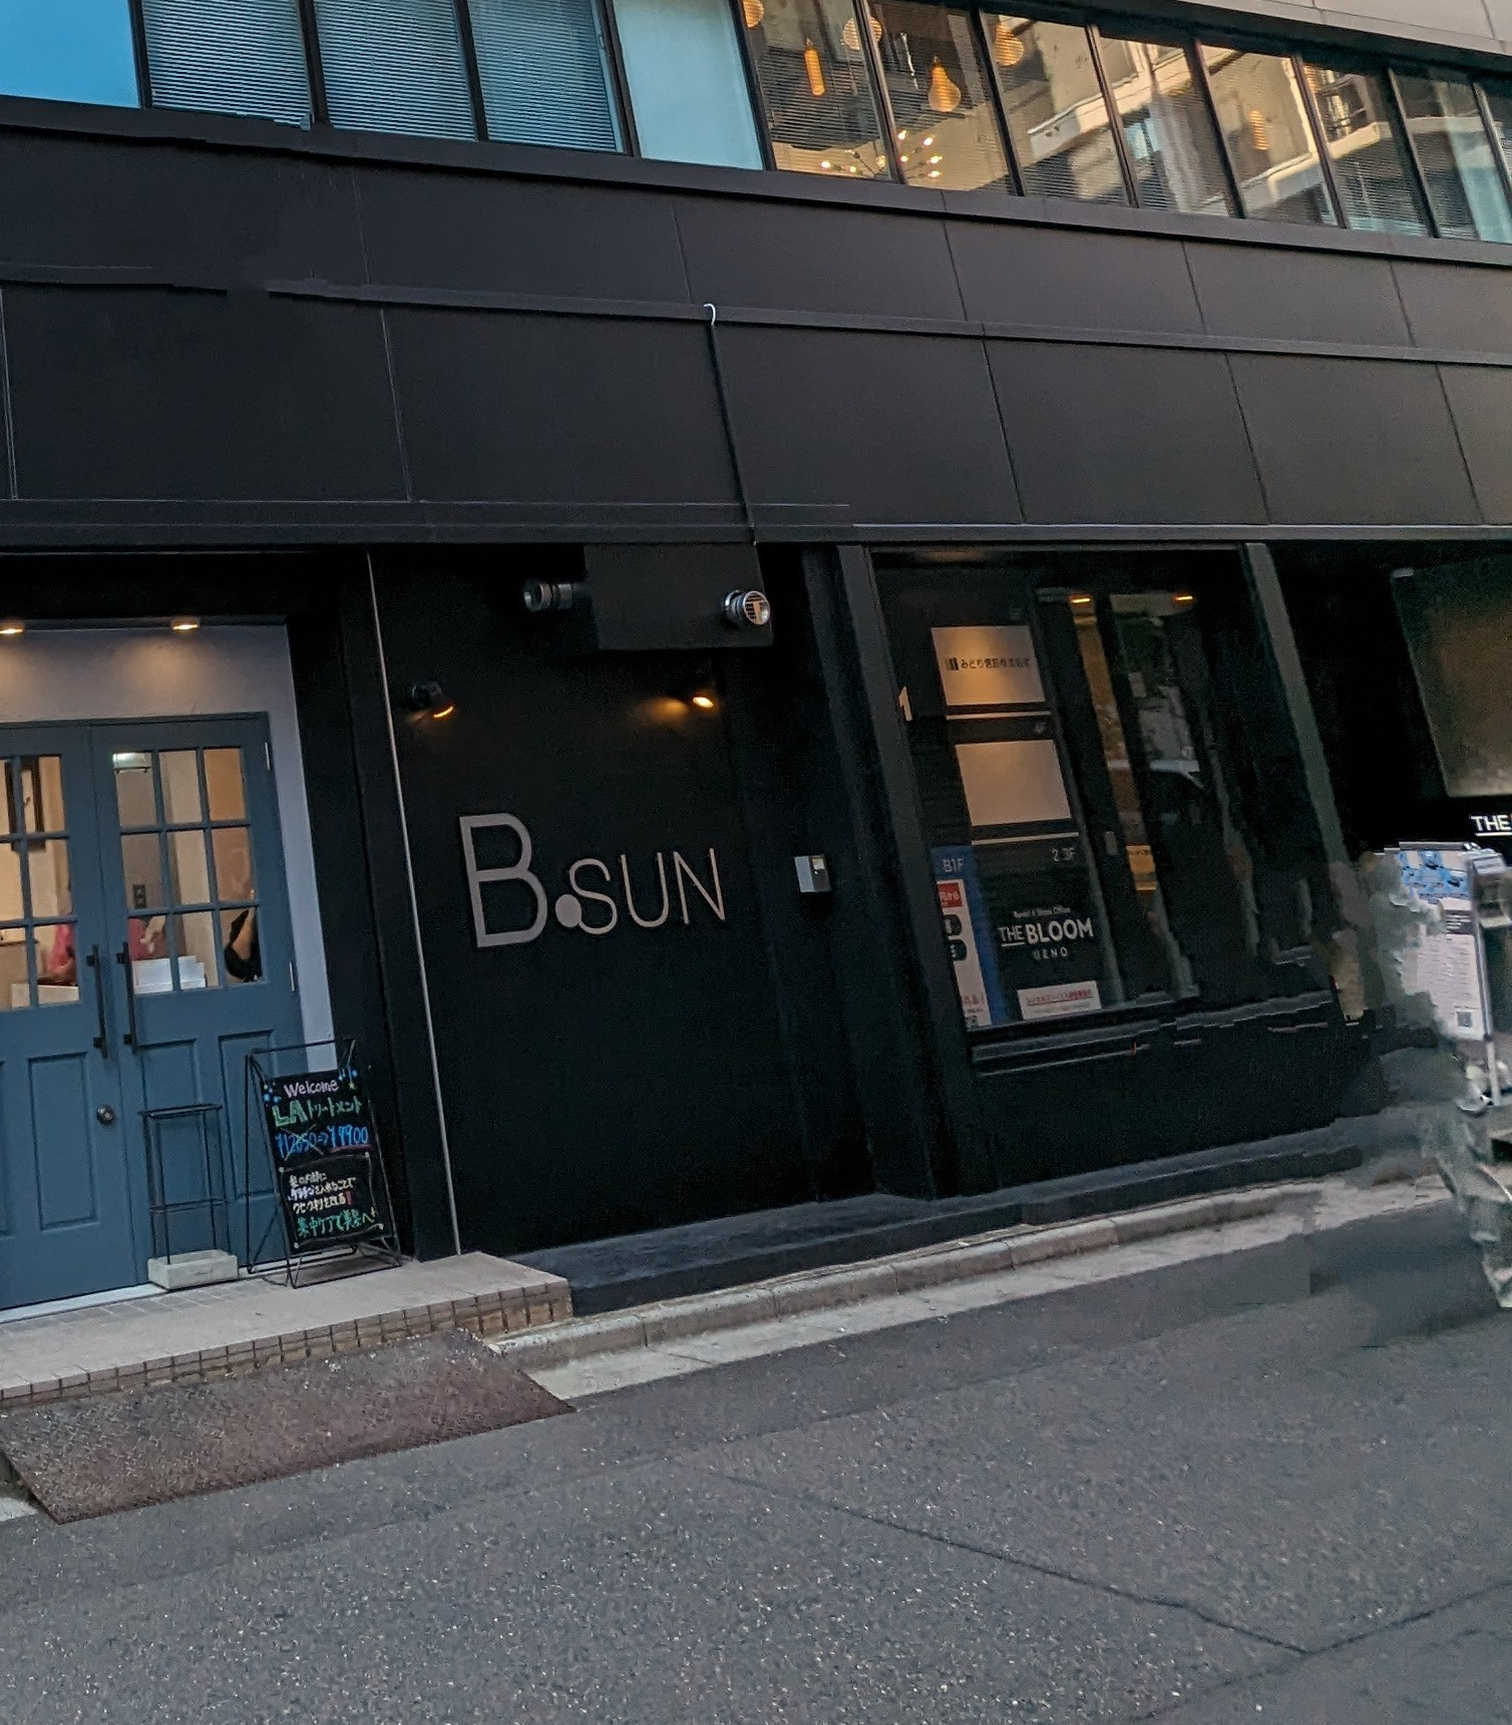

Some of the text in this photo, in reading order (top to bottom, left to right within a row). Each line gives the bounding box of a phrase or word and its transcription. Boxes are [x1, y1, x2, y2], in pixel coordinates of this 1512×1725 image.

[1470, 814, 1511, 832] THE
[942, 857, 964, 873] B1F
[997, 917, 1095, 945] THE BLOOM
[283, 1079, 339, 1098] Welcome
